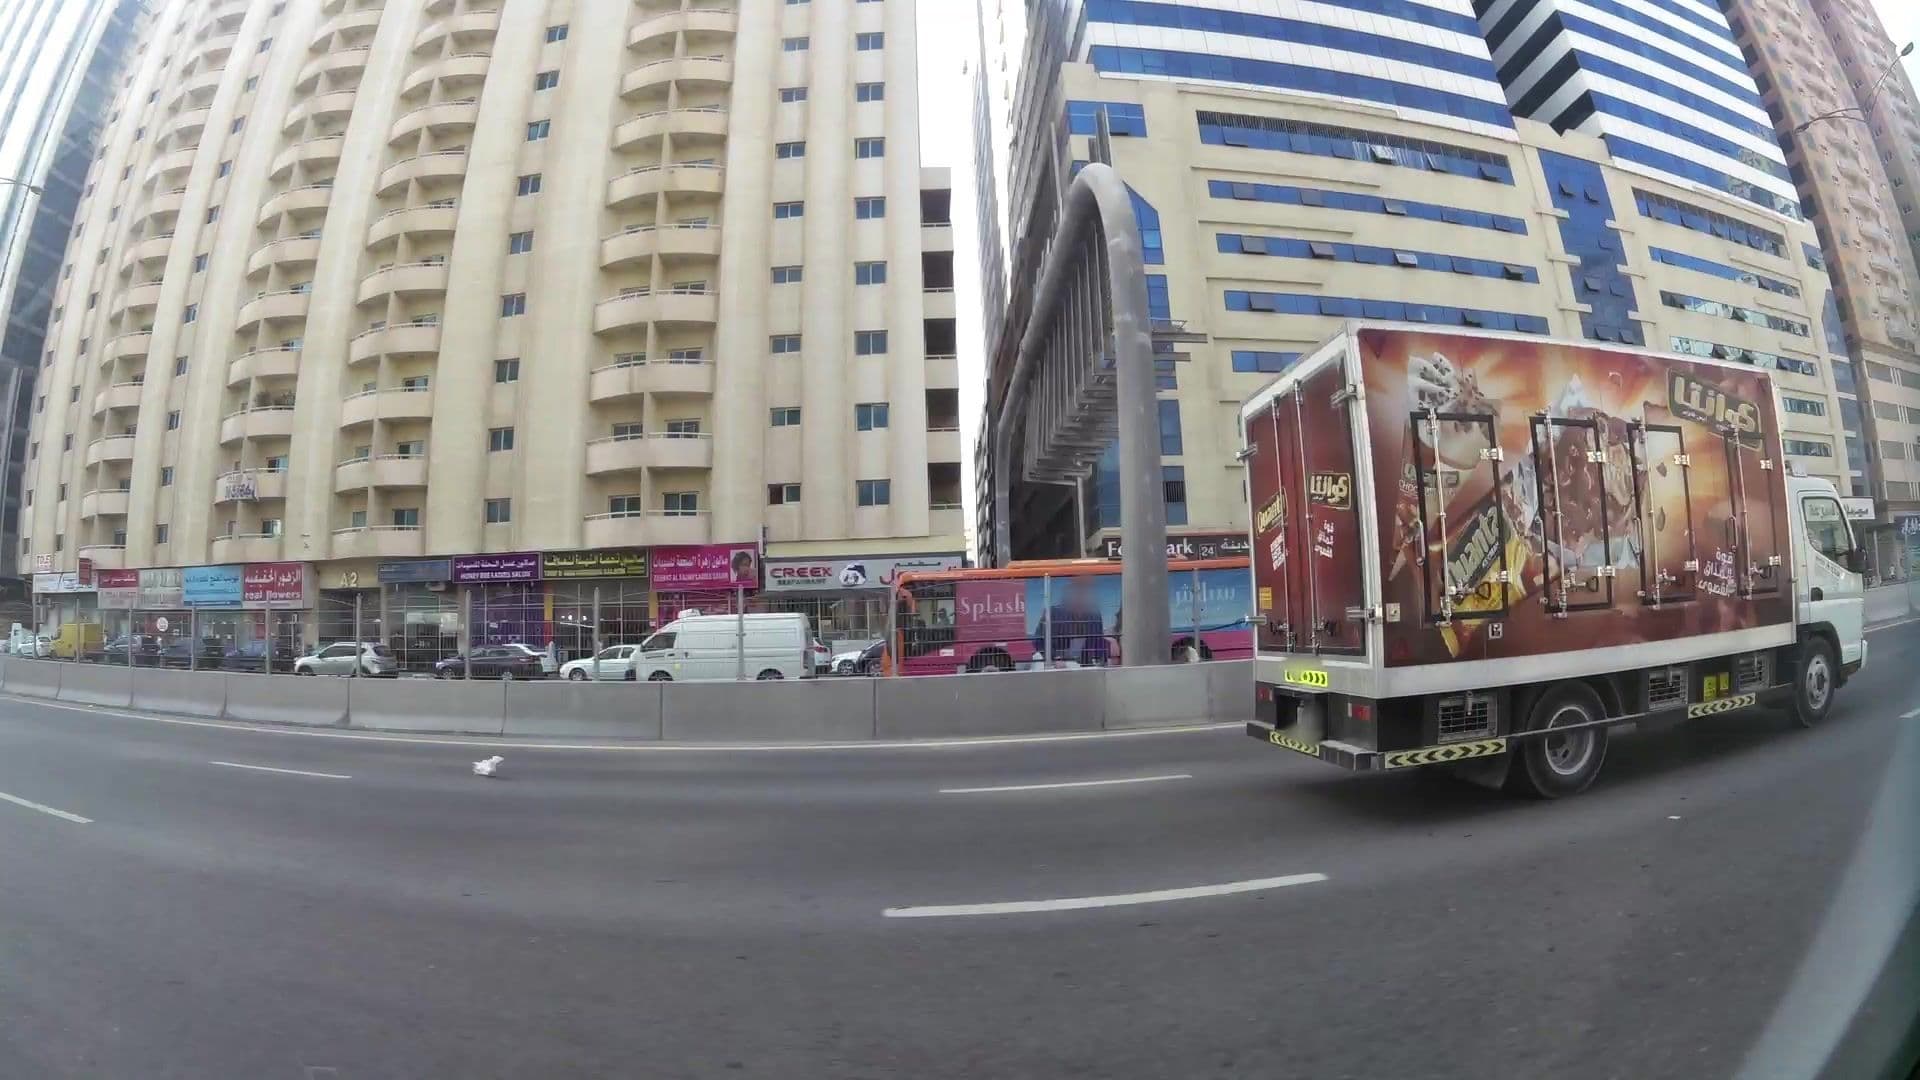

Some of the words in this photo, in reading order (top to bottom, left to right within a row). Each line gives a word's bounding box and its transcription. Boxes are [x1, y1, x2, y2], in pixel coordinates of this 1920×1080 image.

[1220, 538, 1250, 552] دينة
[769, 567, 832, 578] CREEK
[960, 593, 1025, 621] Splash
